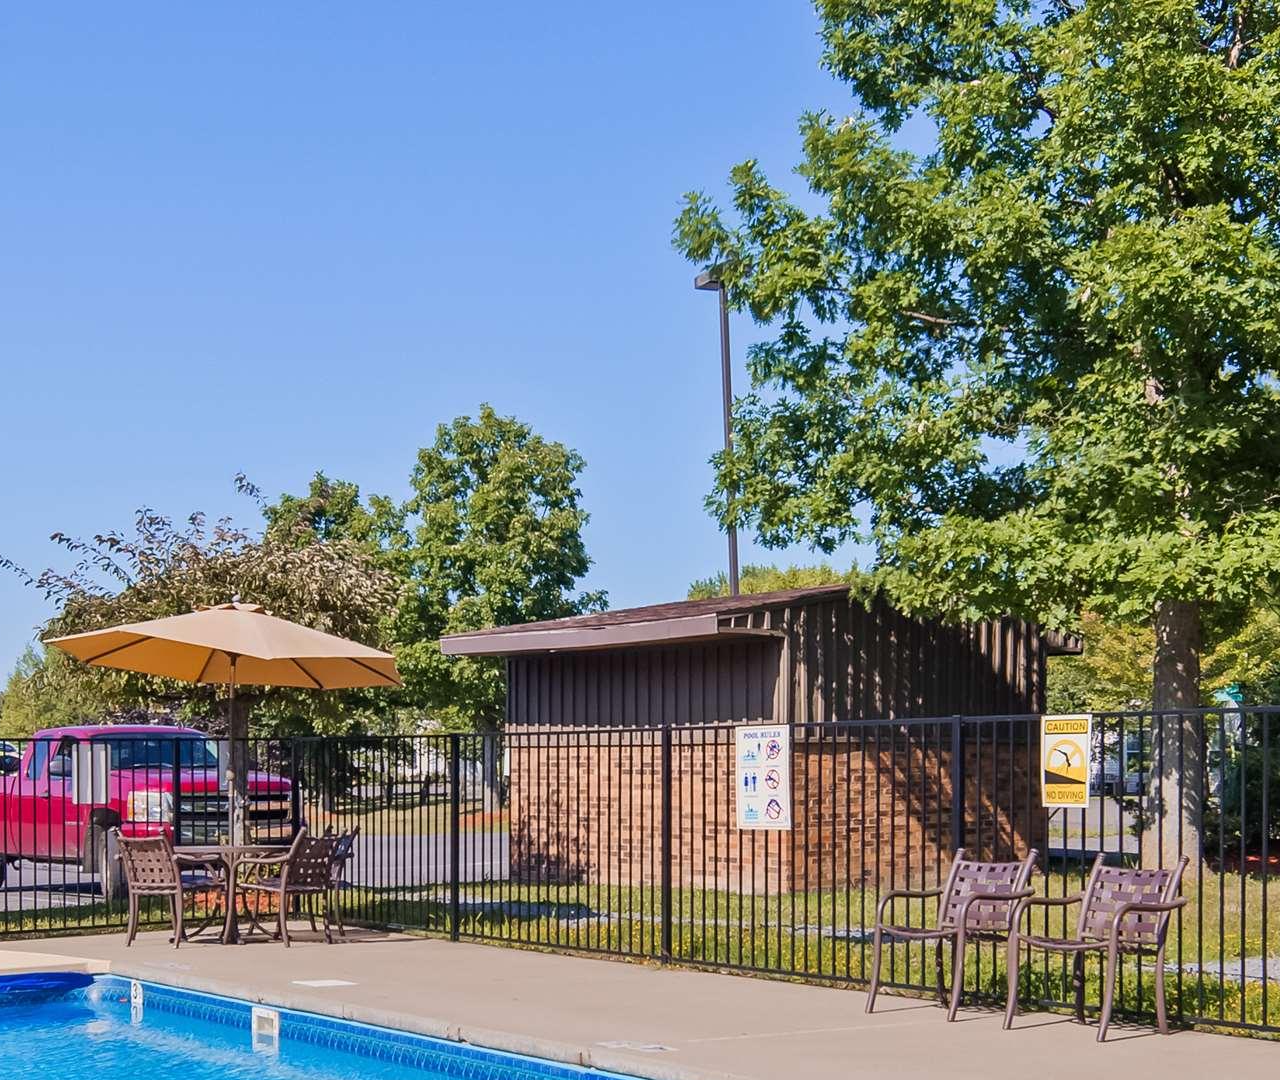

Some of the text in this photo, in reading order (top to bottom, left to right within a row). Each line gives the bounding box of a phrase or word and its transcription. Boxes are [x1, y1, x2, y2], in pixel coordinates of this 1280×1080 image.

[1046, 722, 1086, 731] CAUTION
[1046, 791, 1084, 800] NO DIVING
